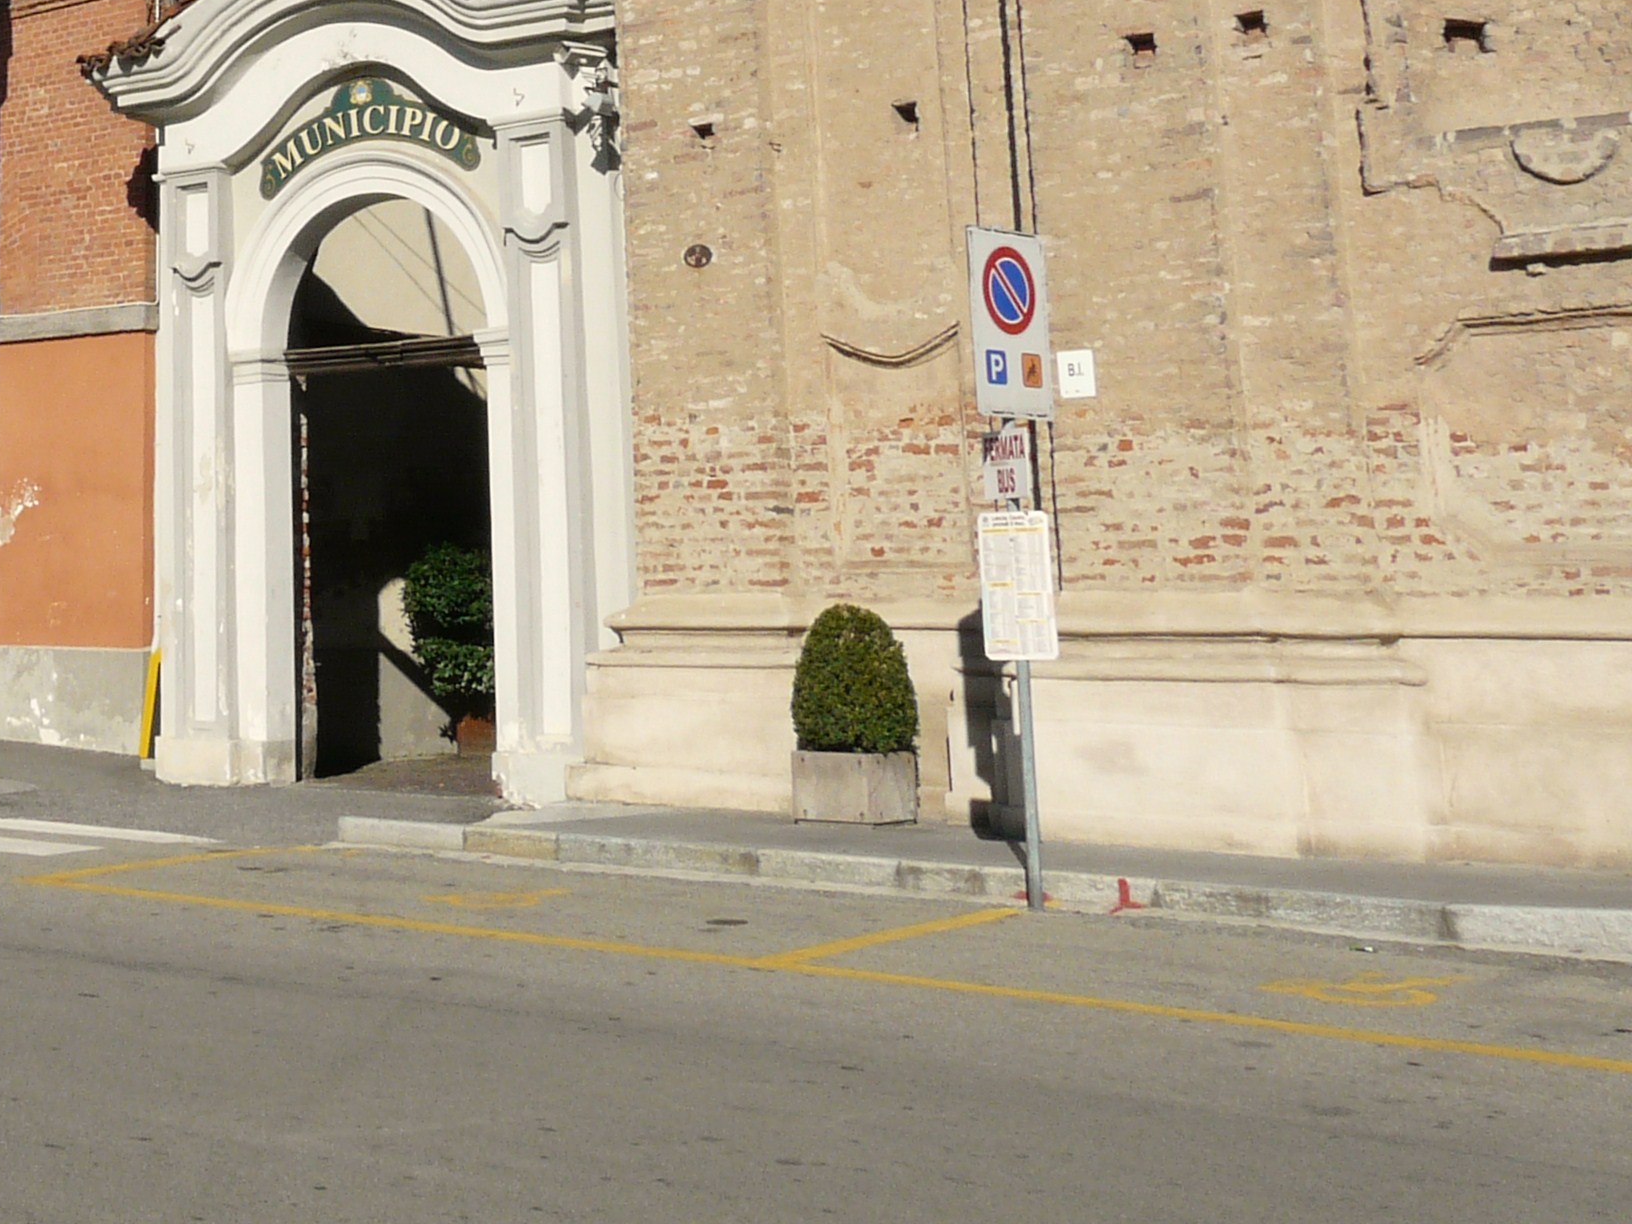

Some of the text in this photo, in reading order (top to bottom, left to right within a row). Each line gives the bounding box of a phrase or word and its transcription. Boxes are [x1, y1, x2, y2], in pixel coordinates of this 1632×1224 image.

[271, 104, 461, 179] MUNICIPIO
[990, 353, 1004, 381] P
[983, 434, 1026, 462] FERMATA
[997, 467, 1016, 493] BUS
